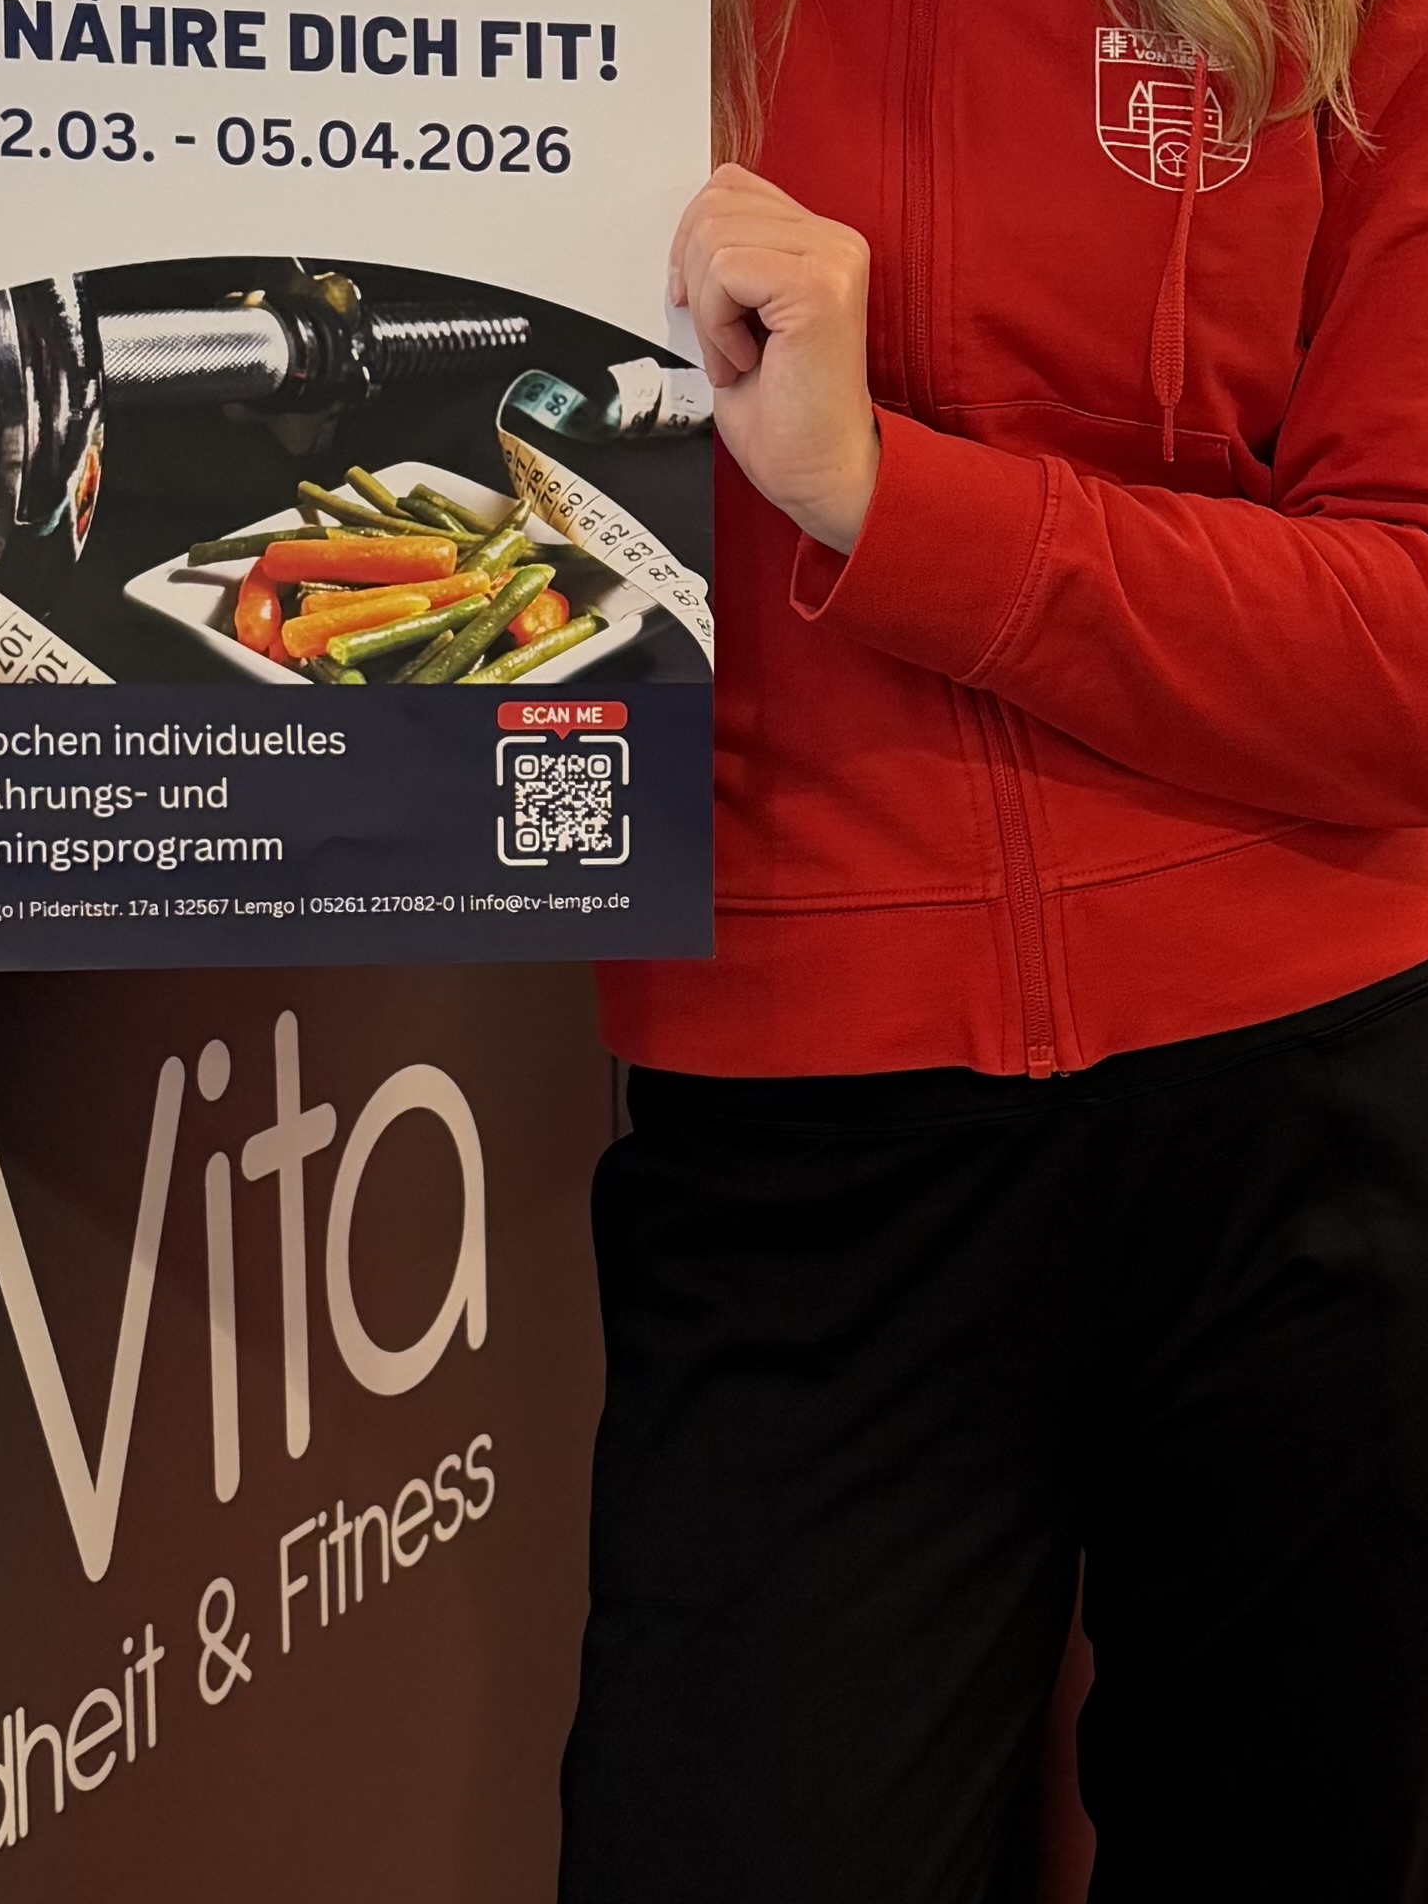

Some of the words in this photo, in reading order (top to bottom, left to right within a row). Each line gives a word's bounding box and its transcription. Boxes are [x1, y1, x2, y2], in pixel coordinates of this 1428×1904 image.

[290, 13, 457, 76] DICH
[481, 21, 617, 81] FIT!
[1135, 49, 1166, 62] VON
[176, 136, 195, 144] -
[218, 117, 570, 173] 05.04.2026
[527, 471, 545, 495] 78
[541, 481, 561, 505] 79
[559, 492, 584, 518] 80
[579, 508, 606, 530] 81
[600, 524, 630, 546] 82
[623, 542, 654, 562] 83
[649, 564, 680, 582] 84
[523, 707, 569, 724] SCAN
[577, 707, 602, 723] ME
[115, 724, 345, 755] individuelles
[160, 777, 227, 808] und
[30, 901, 122, 917] Pideritstr.
[129, 900, 159, 915] 17a
[175, 899, 229, 915] 32567
[235, 899, 294, 918] Lemgo
[311, 897, 366, 913] 05261
[372, 896, 454, 912] 217082-0
[471, 893, 629, 913] info@tv-lemgo.de
[198, 1577, 251, 1704] &
[280, 1433, 495, 1653] Fitness
